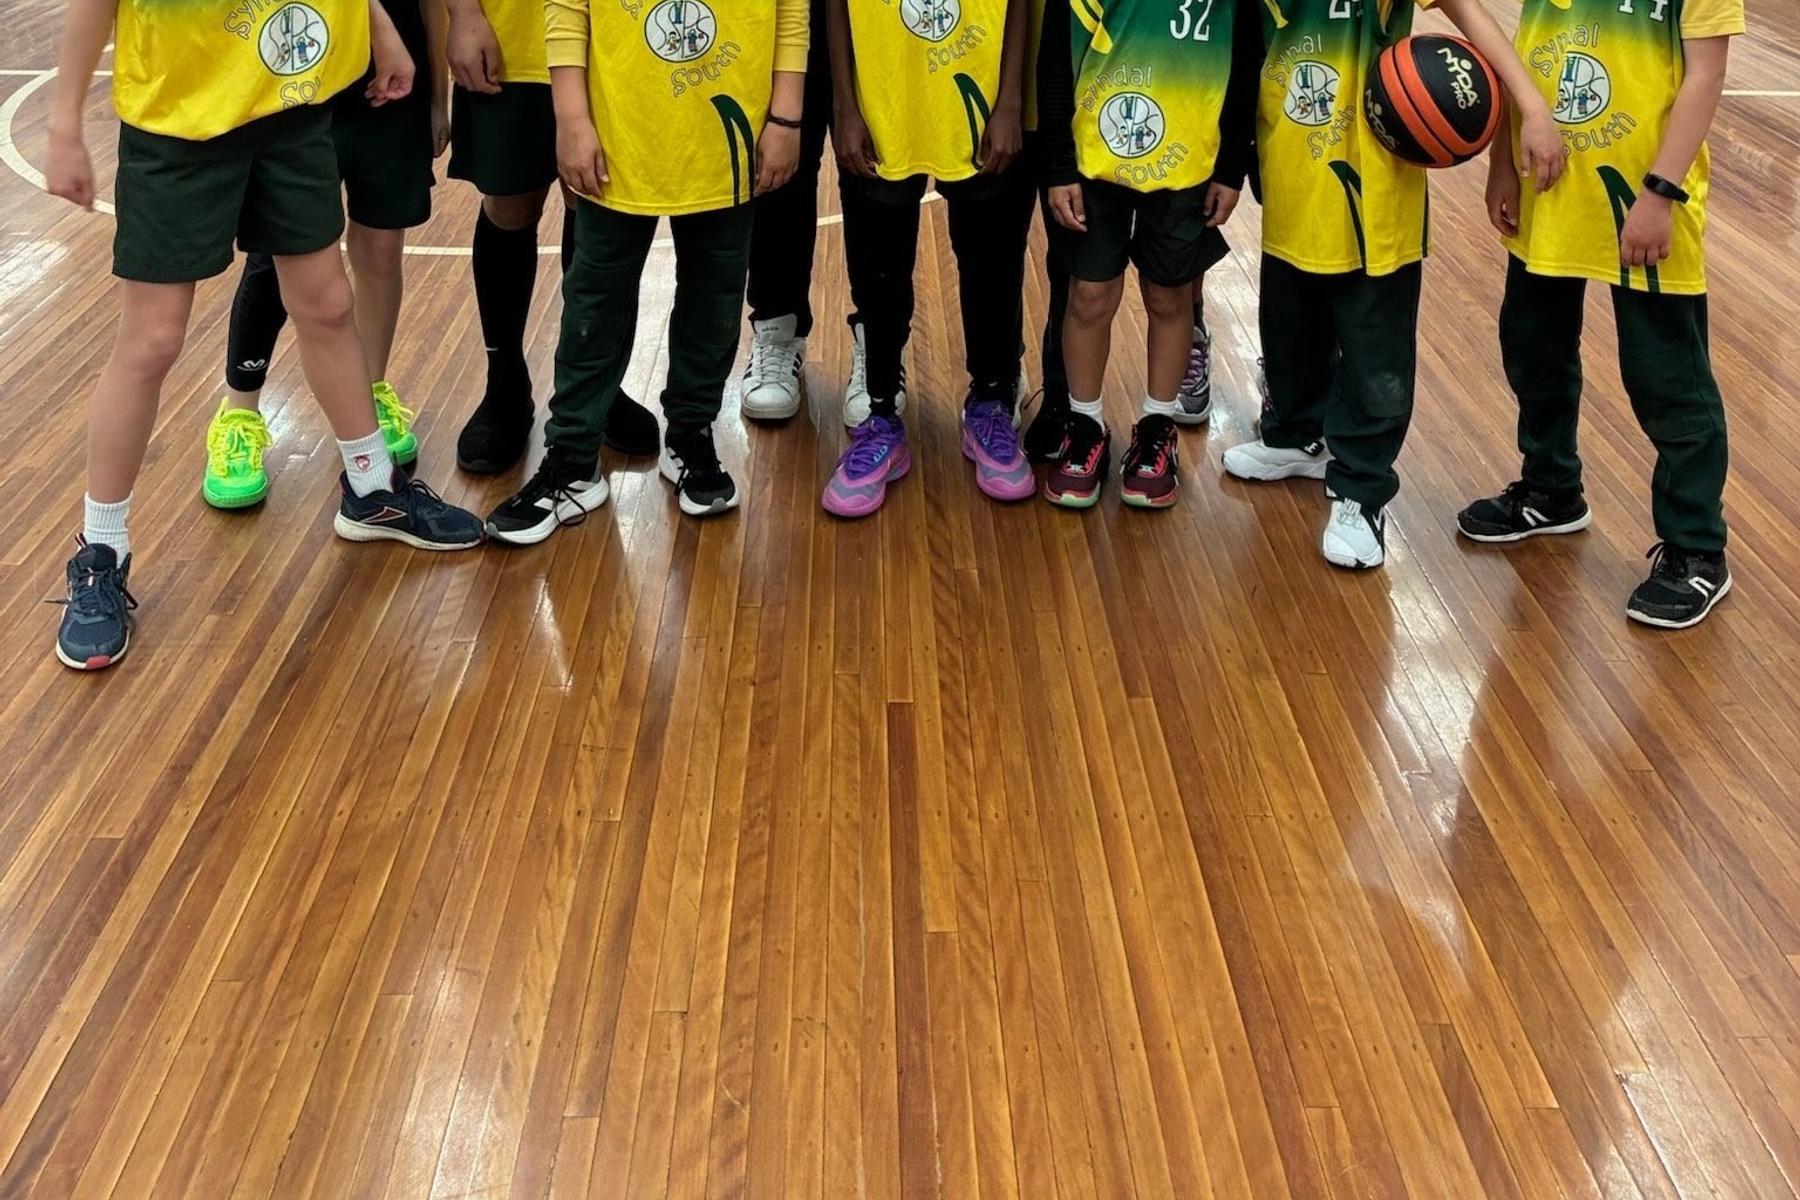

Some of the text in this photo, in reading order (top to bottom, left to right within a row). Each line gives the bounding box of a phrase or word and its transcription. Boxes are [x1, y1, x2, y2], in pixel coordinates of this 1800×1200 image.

[670, 40, 741, 98] South
[925, 23, 987, 74] South
[1450, 81, 1467, 110] PRO
[1306, 105, 1356, 160] Suth
[1115, 142, 1188, 187] South
